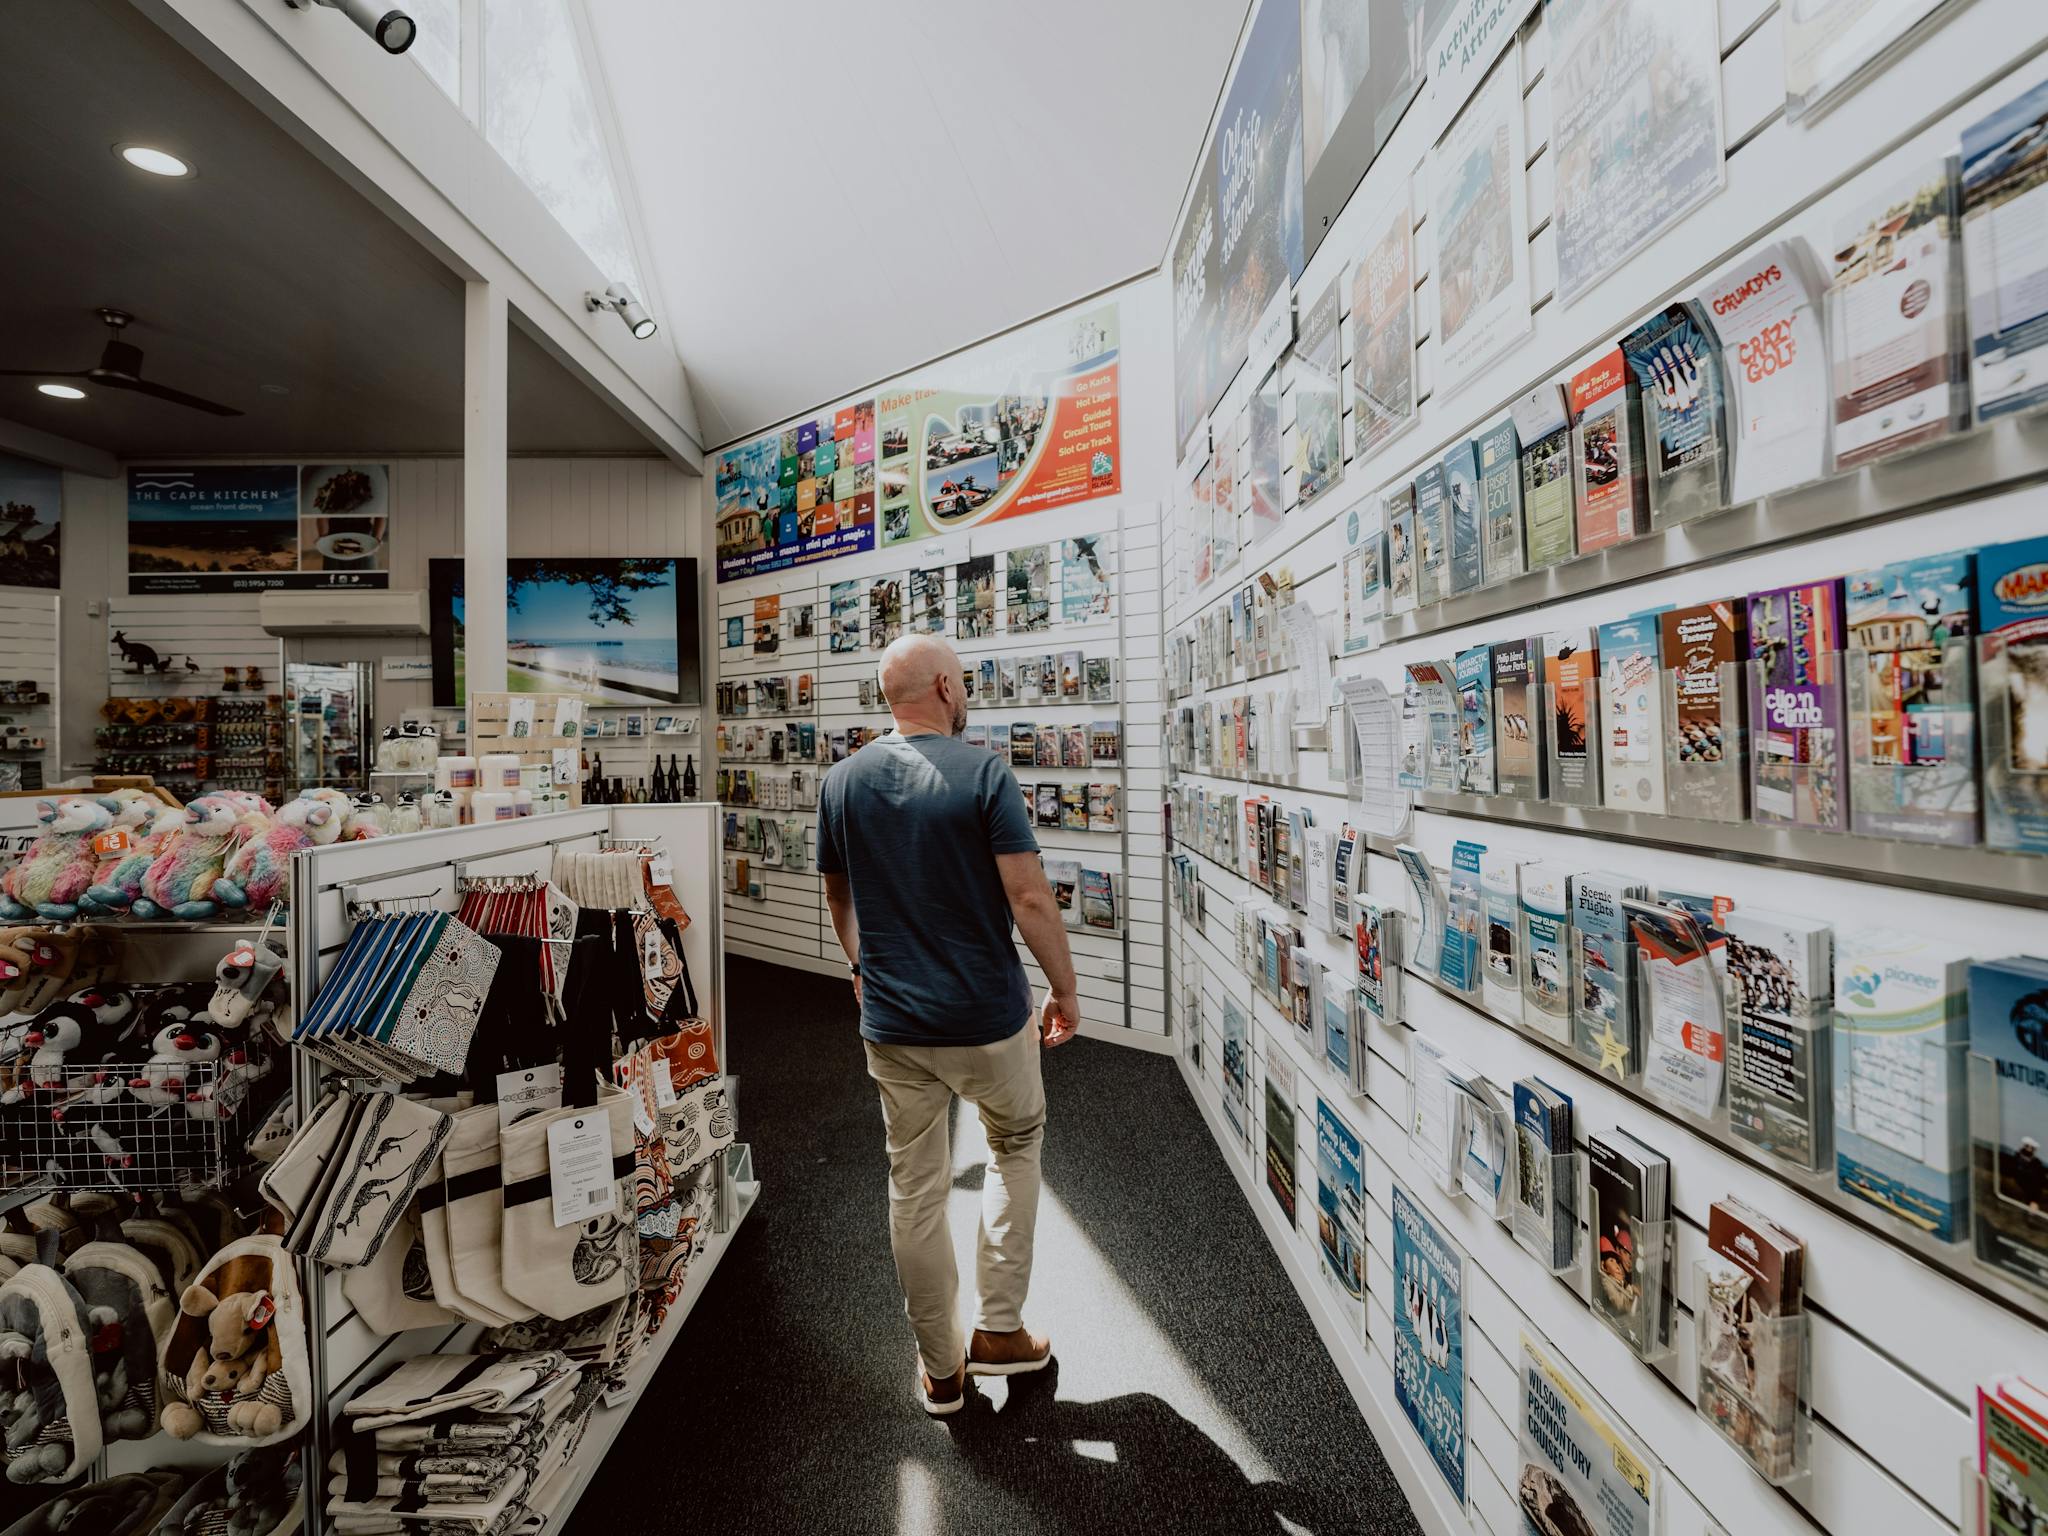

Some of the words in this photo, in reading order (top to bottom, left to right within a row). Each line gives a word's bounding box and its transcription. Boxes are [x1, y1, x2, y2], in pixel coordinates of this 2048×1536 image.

[1438, 0, 1488, 76] Activiti
[1461, 0, 1511, 73] Attrac
[1222, 108, 1243, 176] Our
[1712, 264, 1782, 315] GRUMPYS
[1739, 315, 1797, 365] CRAZY
[1076, 381, 1088, 393] Go
[1089, 374, 1111, 389] Karts
[1575, 381, 1590, 397] Make
[1591, 370, 1610, 386] Tracks
[1585, 391, 1592, 400] to
[1592, 384, 1603, 396] the
[1603, 373, 1622, 390] Circuit
[881, 394, 912, 414] Make
[1076, 396, 1090, 409] Hot
[1092, 392, 1112, 407] Laps
[1082, 408, 1112, 424] Guided
[1063, 425, 1089, 441] Circuit
[1089, 420, 1112, 434] Tours
[1494, 428, 1511, 447] BASS
[1058, 444, 1075, 457] Slot
[1076, 441, 1090, 453] Car
[1090, 434, 1113, 449] Track
[1091, 473, 1113, 482] PHILLIP
[1091, 480, 1113, 489] ISLAND
[136, 491, 161, 501] THE
[169, 491, 205, 501] CAPE
[213, 490, 279, 500] KITCHEN
[216, 502, 237, 511] front
[238, 502, 263, 512] dining
[723, 557, 746, 569] illusions
[751, 551, 774, 563] puzzles
[779, 545, 800, 557] mazes
[806, 537, 821, 551] mini
[822, 534, 836, 548] golf
[842, 529, 866, 543] magic
[924, 547, 945, 558] Touring
[1677, 622, 1718, 636] Chocolate
[1681, 632, 1714, 645] Factory
[387, 662, 404, 670] Local
[1457, 651, 1487, 671] ANTARCTIC
[1496, 653, 1510, 665] Phillip
[1509, 650, 1524, 662] Island
[1512, 660, 1527, 672] Parks
[1458, 662, 1485, 681] JOURNEY
[1581, 885, 1612, 903] Scenic
[1579, 897, 1614, 917] Flights
[1884, 965, 1940, 990] pioneer
[1665, 1066, 1678, 1076] CAR
[1679, 1071, 1694, 1083] HIRE
[1995, 1057, 2048, 1091] NATUR
[1318, 1111, 1338, 1149] Phillip
[1339, 1136, 1360, 1174] Island
[1319, 1130, 1342, 1169] Cruises
[1394, 1197, 1423, 1240] TENPIN
[1421, 1230, 1460, 1284] BOWLING
[1396, 1326, 1420, 1373] OPEN
[1423, 1360, 1431, 1385] 7
[1434, 1381, 1462, 1436] DAYS
[1528, 1367, 1567, 1427] WILSONS
[1528, 1390, 1591, 1481] PROMONTORY
[1528, 1414, 1564, 1474] CRUISES
